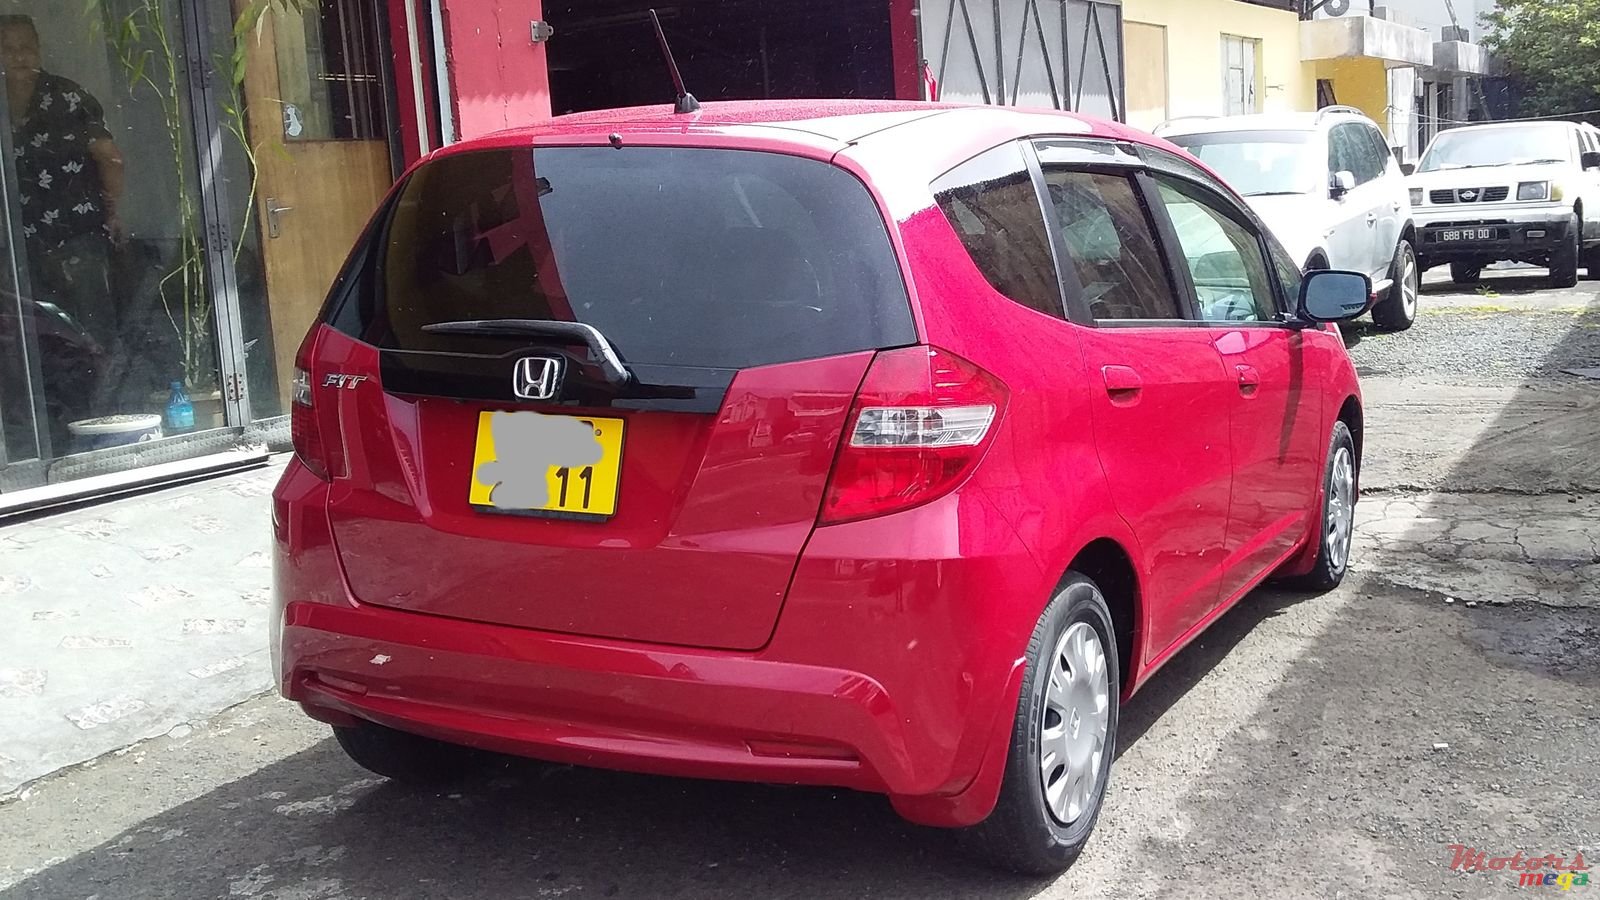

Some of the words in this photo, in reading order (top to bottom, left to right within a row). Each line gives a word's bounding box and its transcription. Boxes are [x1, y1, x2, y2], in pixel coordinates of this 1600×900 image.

[1443, 231, 1460, 241] 688
[1463, 229, 1475, 240] FB
[322, 373, 368, 389] FIT
[555, 466, 593, 509] 11
